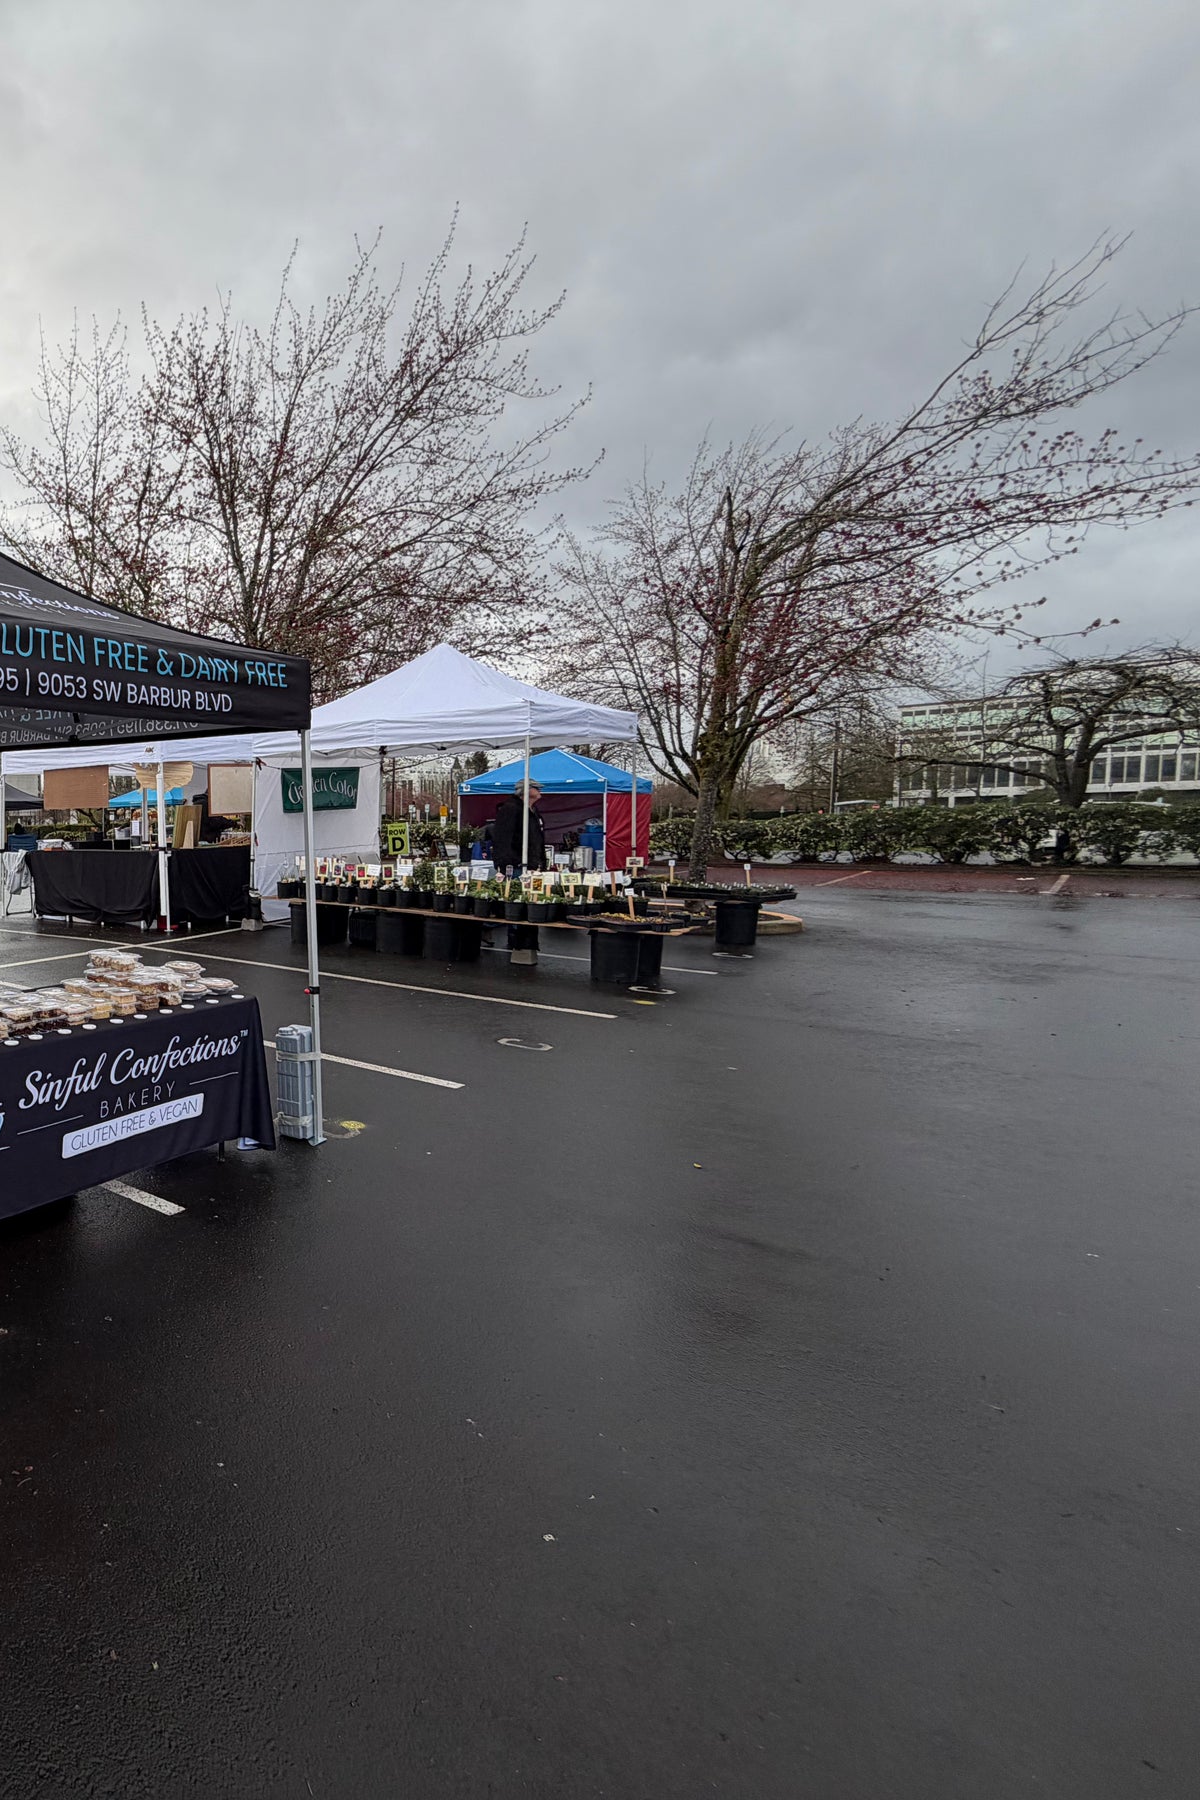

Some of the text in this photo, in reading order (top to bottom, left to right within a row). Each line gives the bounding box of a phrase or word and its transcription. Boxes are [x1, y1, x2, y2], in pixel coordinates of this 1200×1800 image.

[93, 638, 149, 673] FREE
[156, 648, 174, 677] &
[177, 652, 239, 685] DAIRY
[244, 660, 289, 689] FREE
[37, 671, 88, 699] 9053
[92, 679, 122, 703] SW
[126, 683, 192, 711] BARBUR
[194, 690, 233, 713] BLVD
[388, 828, 406, 836] ROW
[391, 836, 405, 853] D
[18, 1052, 108, 1112] Sinful
[99, 1081, 177, 1119] BAKERY
[70, 1098, 199, 1151] GLUTEN FREE & VEGAN
